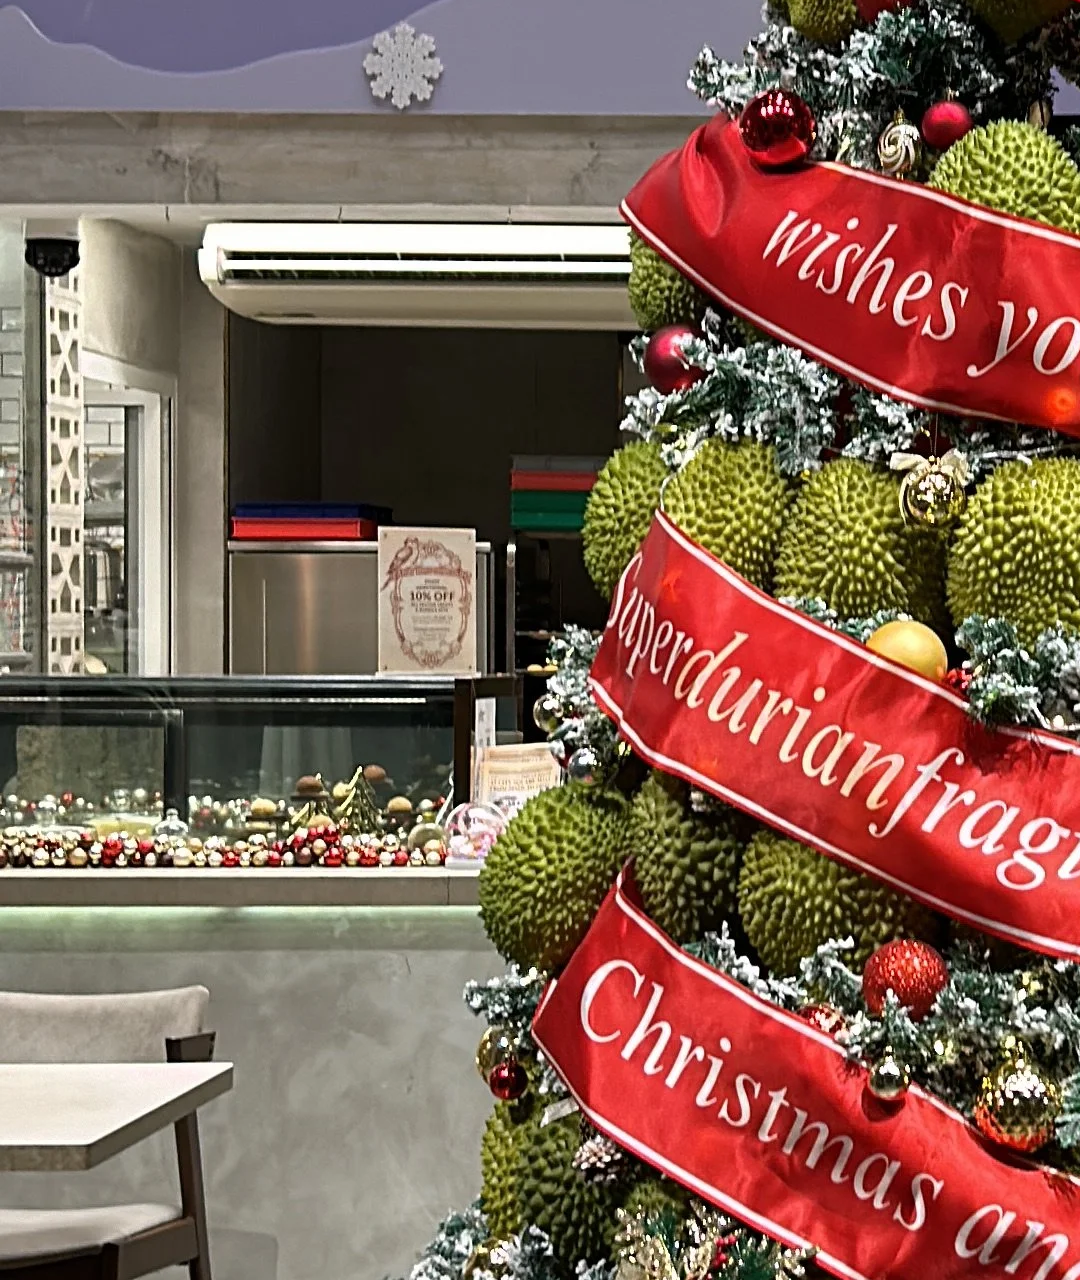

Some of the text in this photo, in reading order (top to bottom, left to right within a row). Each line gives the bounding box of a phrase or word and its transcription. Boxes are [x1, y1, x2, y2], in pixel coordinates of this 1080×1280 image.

[762, 210, 968, 341] wishes
[411, 591, 454, 601] 10% OFF
[580, 960, 943, 1231] Christmas
